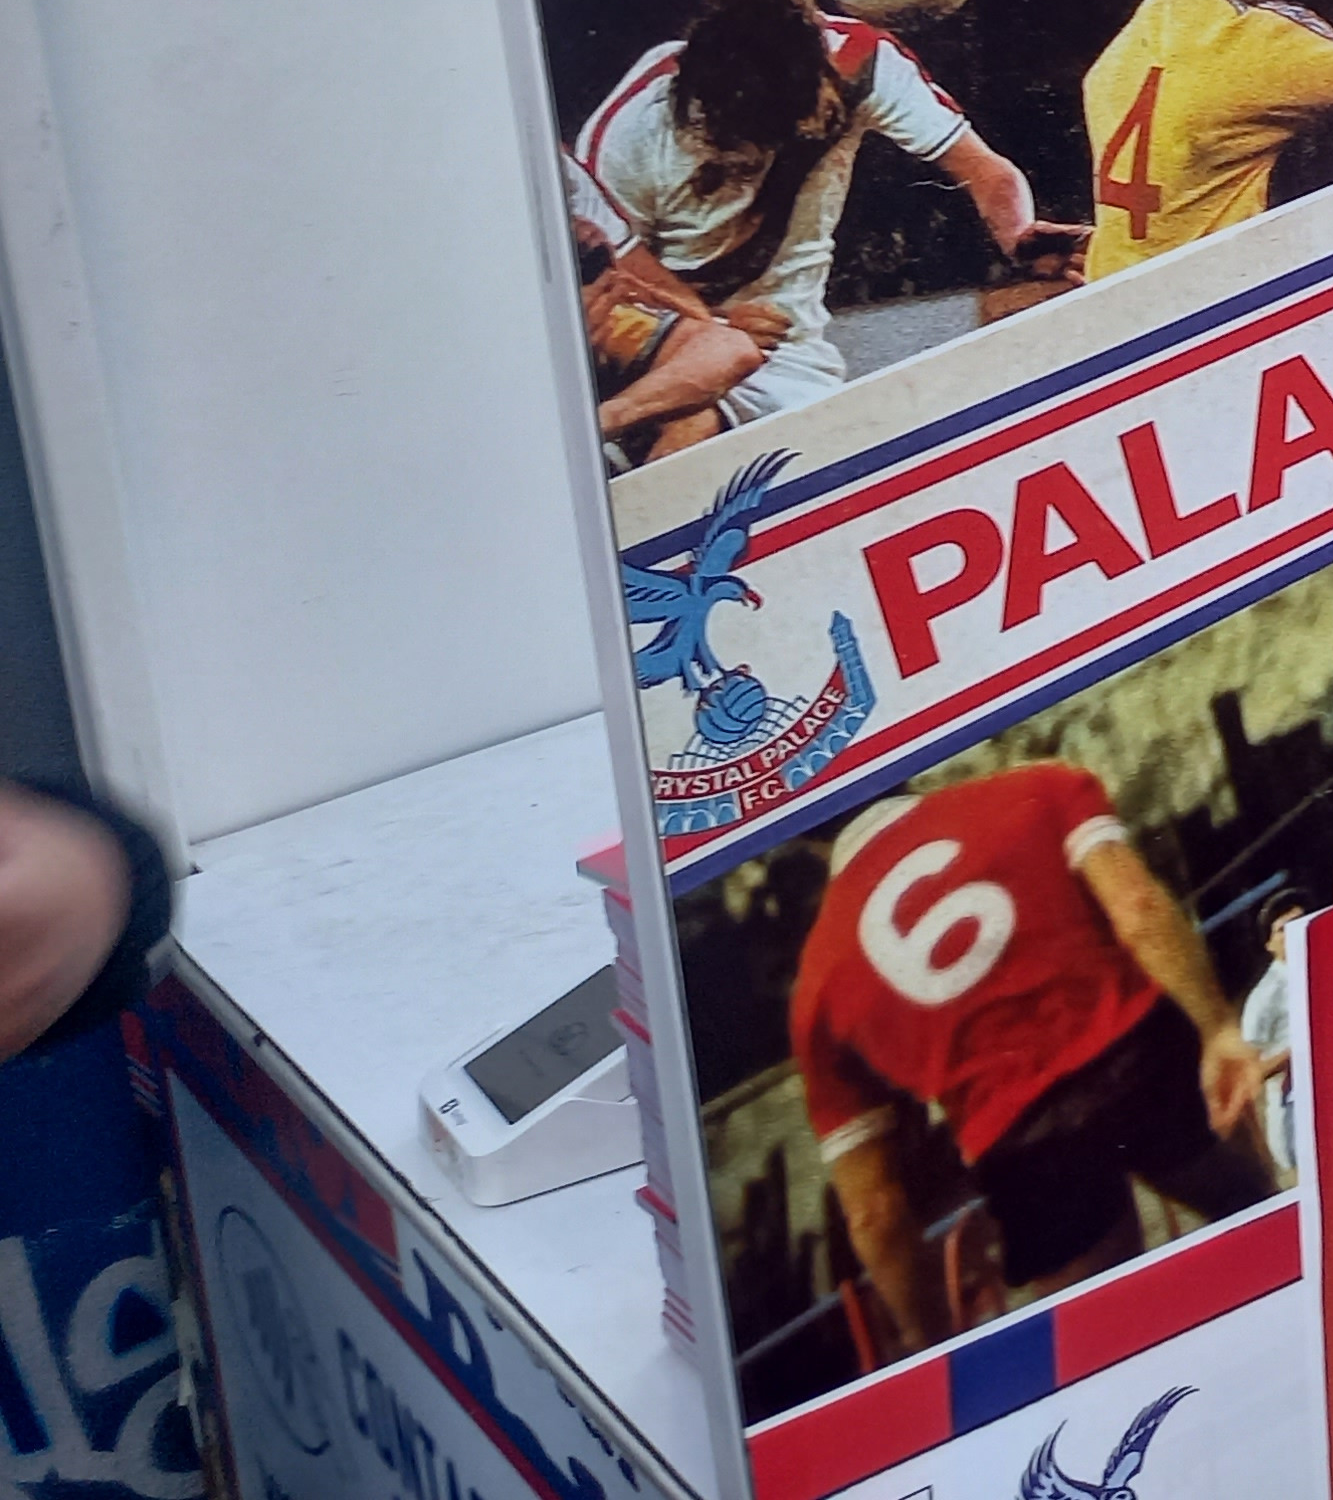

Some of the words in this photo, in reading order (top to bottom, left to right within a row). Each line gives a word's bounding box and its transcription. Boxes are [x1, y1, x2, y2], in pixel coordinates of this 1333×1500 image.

[1096, 65, 1165, 241] 4
[650, 762, 760, 796] RYSTAL
[760, 686, 846, 768] PALACE
[858, 838, 1016, 1006] 6
